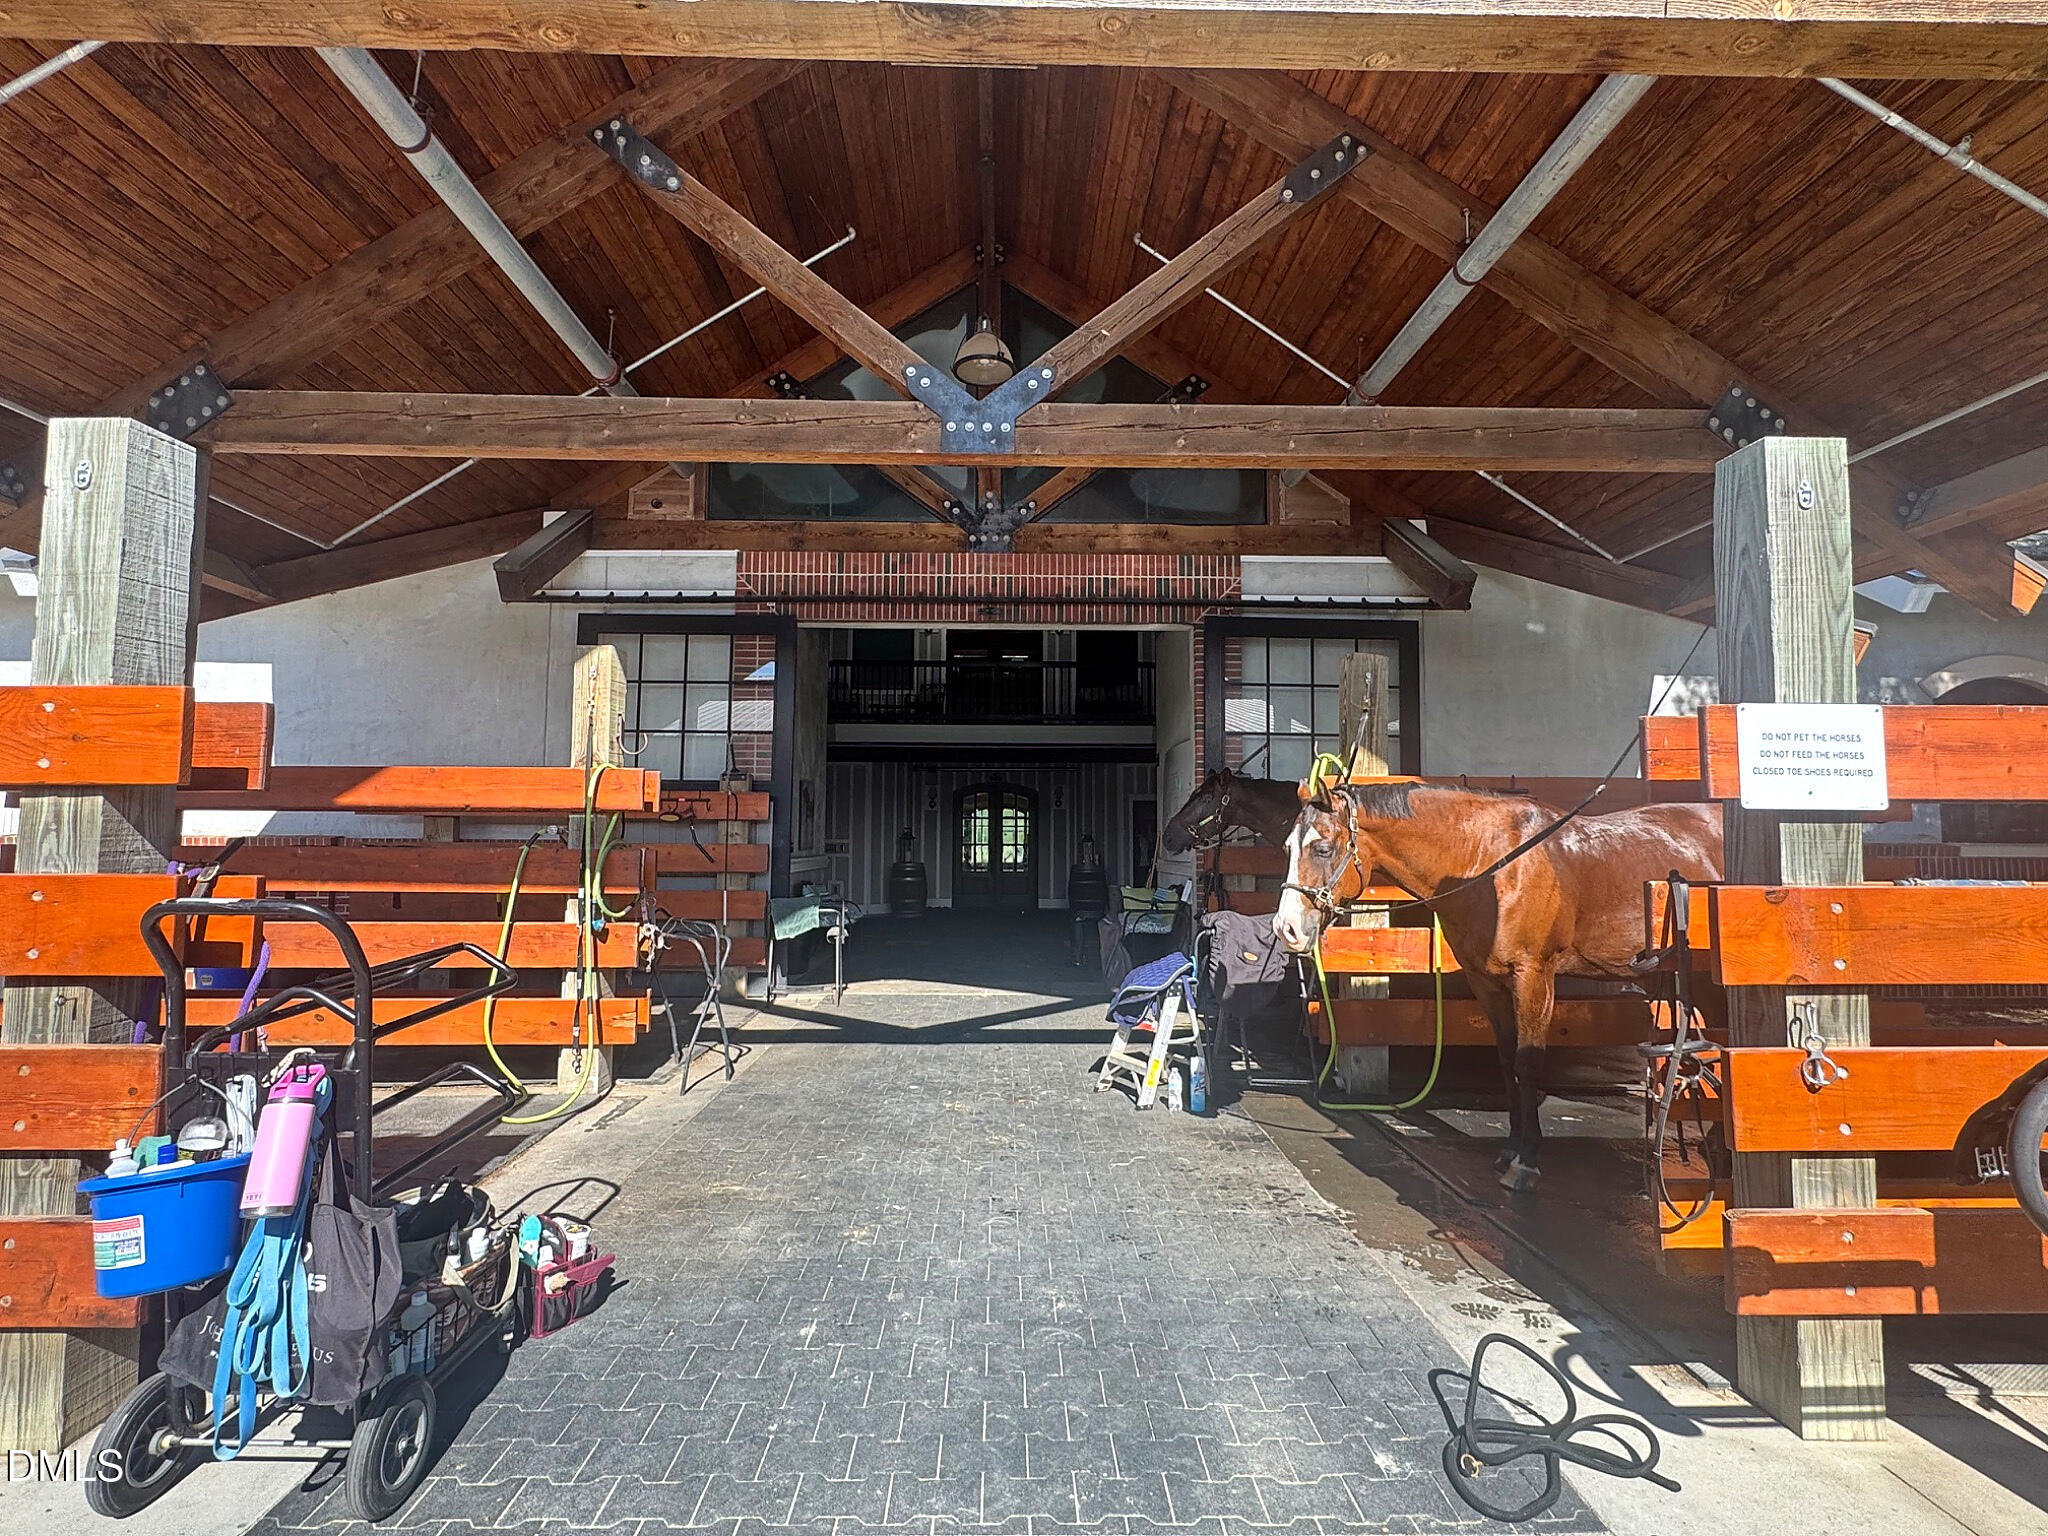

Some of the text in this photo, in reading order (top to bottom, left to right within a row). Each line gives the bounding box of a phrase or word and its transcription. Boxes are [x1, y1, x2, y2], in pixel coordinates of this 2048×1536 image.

[1776, 733, 1791, 741] NOT
[1794, 733, 1809, 741] PET
[1812, 734, 1827, 742] THE
[1830, 734, 1861, 742] HORSES
[1760, 750, 1771, 758] DO
[1774, 750, 1789, 758] NOT
[1816, 751, 1830, 759] THE
[1753, 767, 1784, 775] CLOSED
[1805, 768, 1831, 776] SHOES
[1833, 769, 1873, 777] REQUIRED
